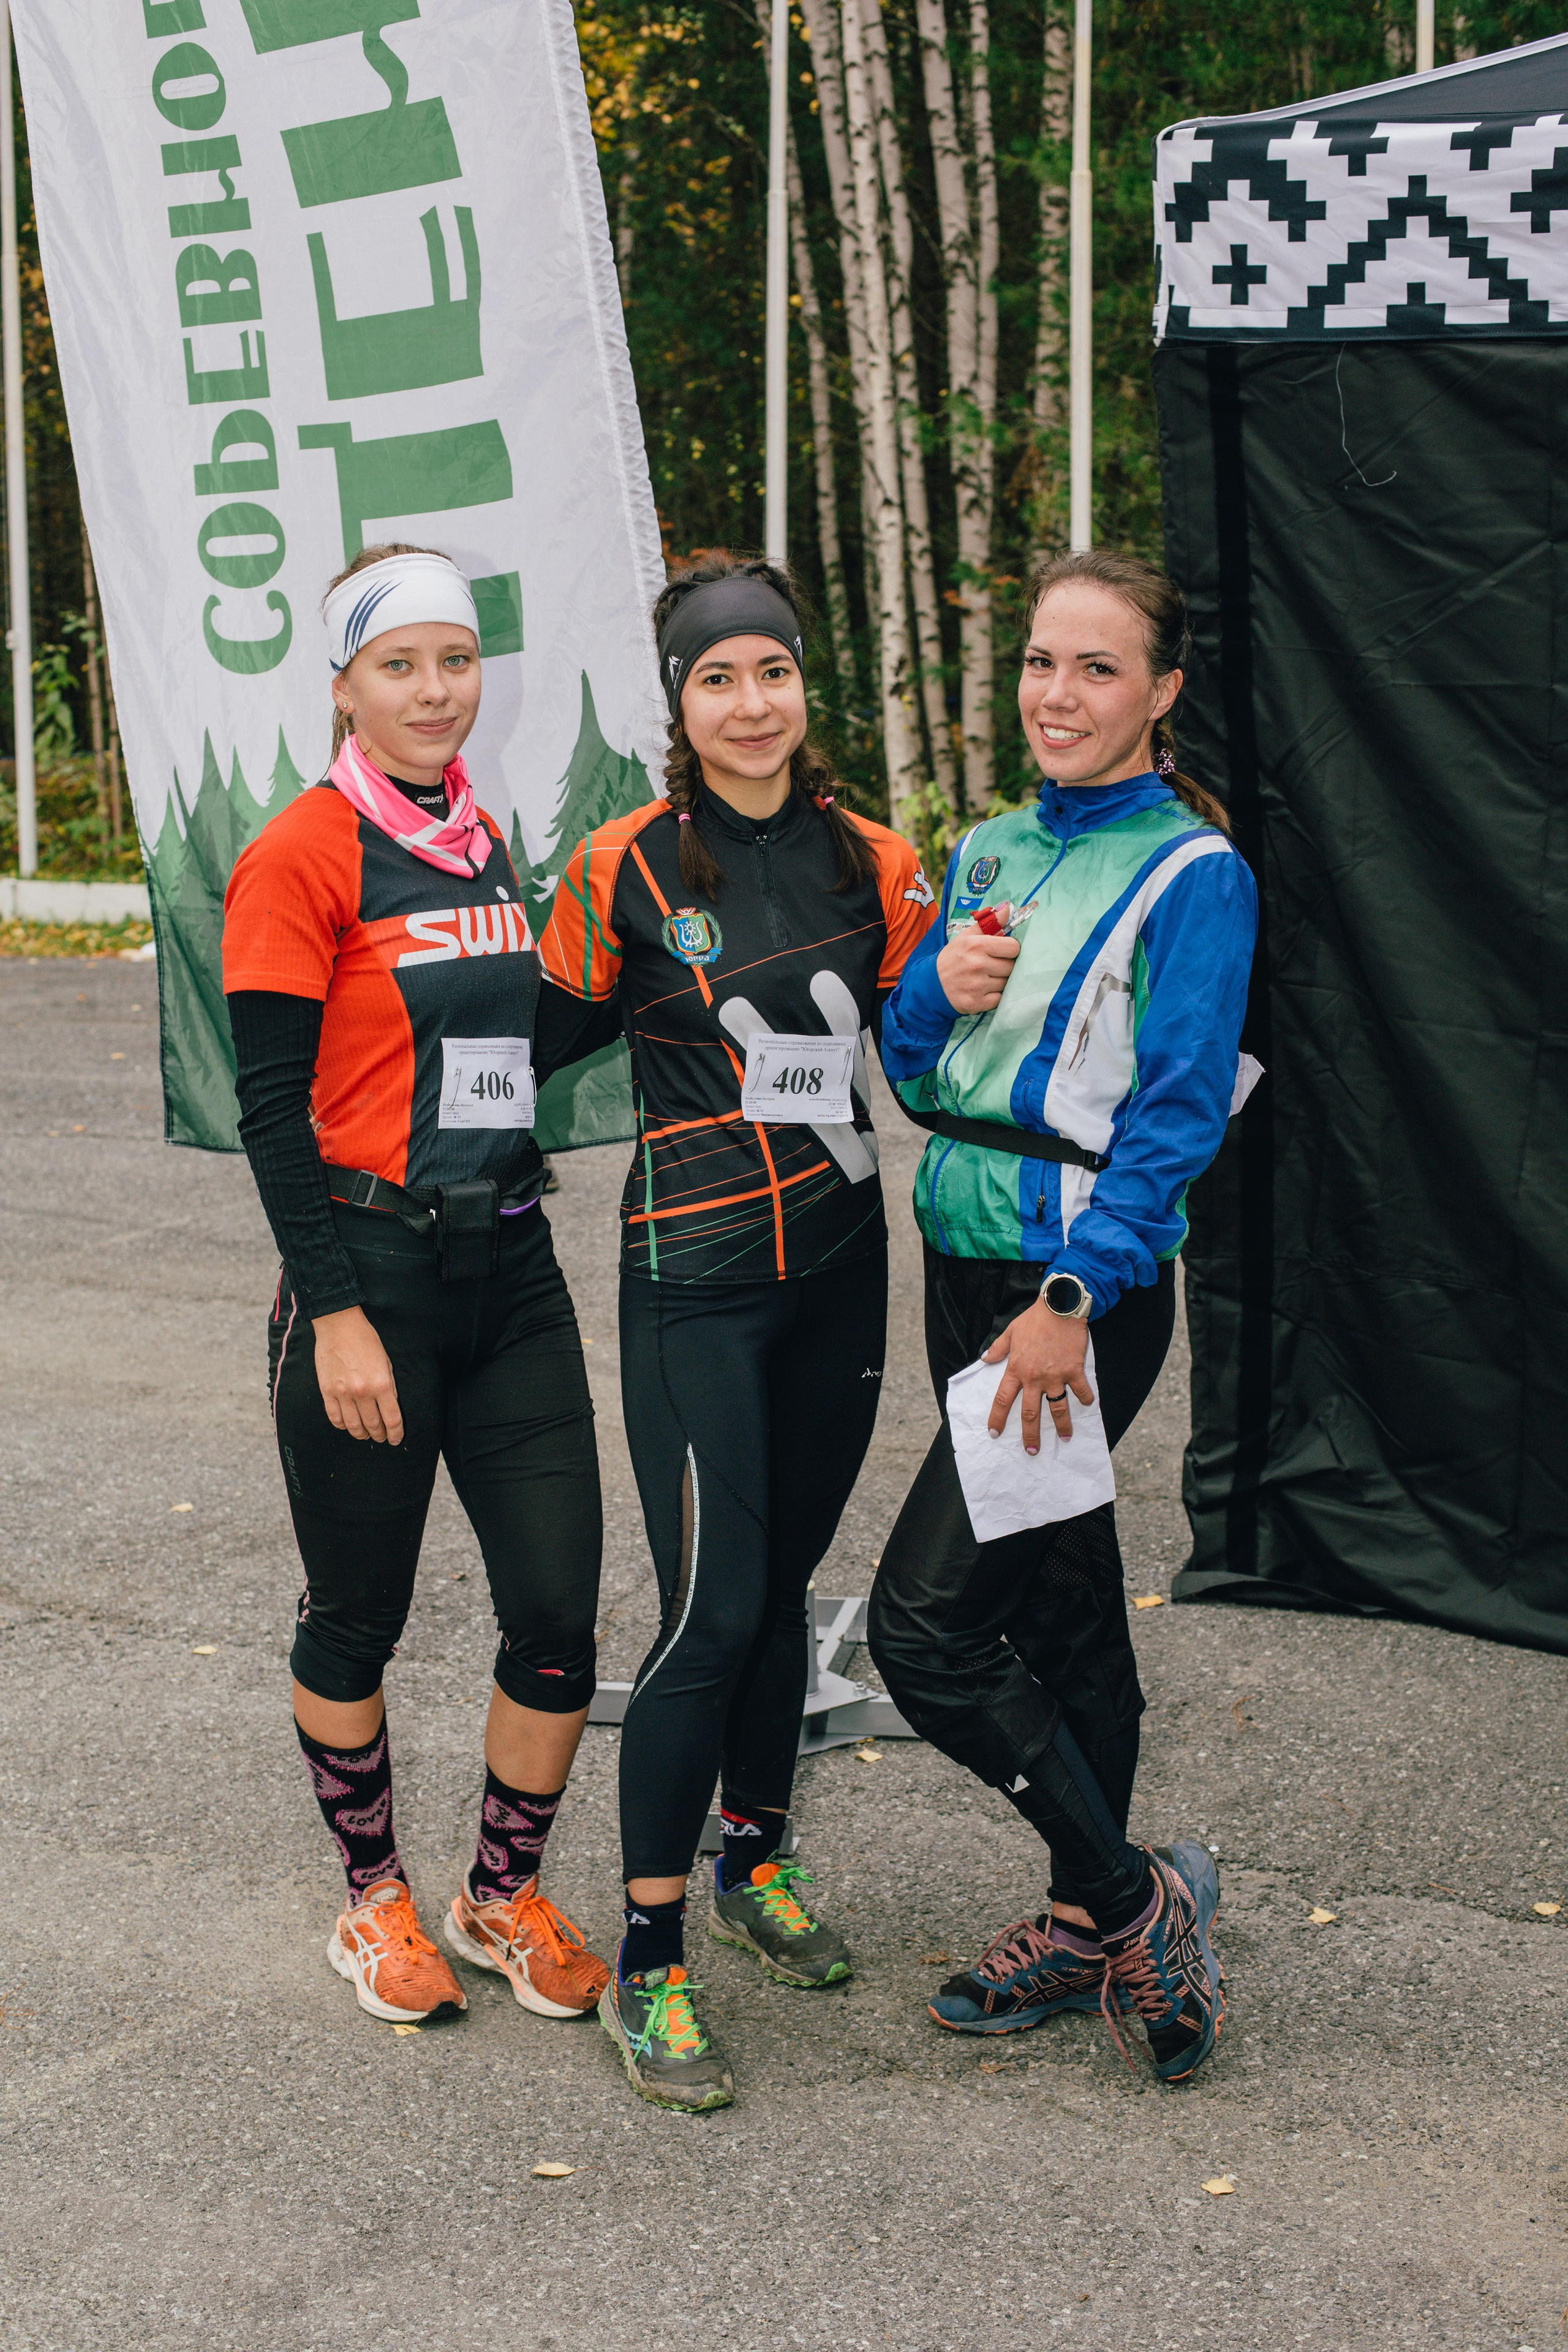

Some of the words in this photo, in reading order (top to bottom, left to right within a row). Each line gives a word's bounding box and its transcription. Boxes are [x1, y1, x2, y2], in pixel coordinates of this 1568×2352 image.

[417, 795, 442, 804] CRAFT
[470, 1071, 514, 1100] 406
[772, 1066, 824, 1095] 408
